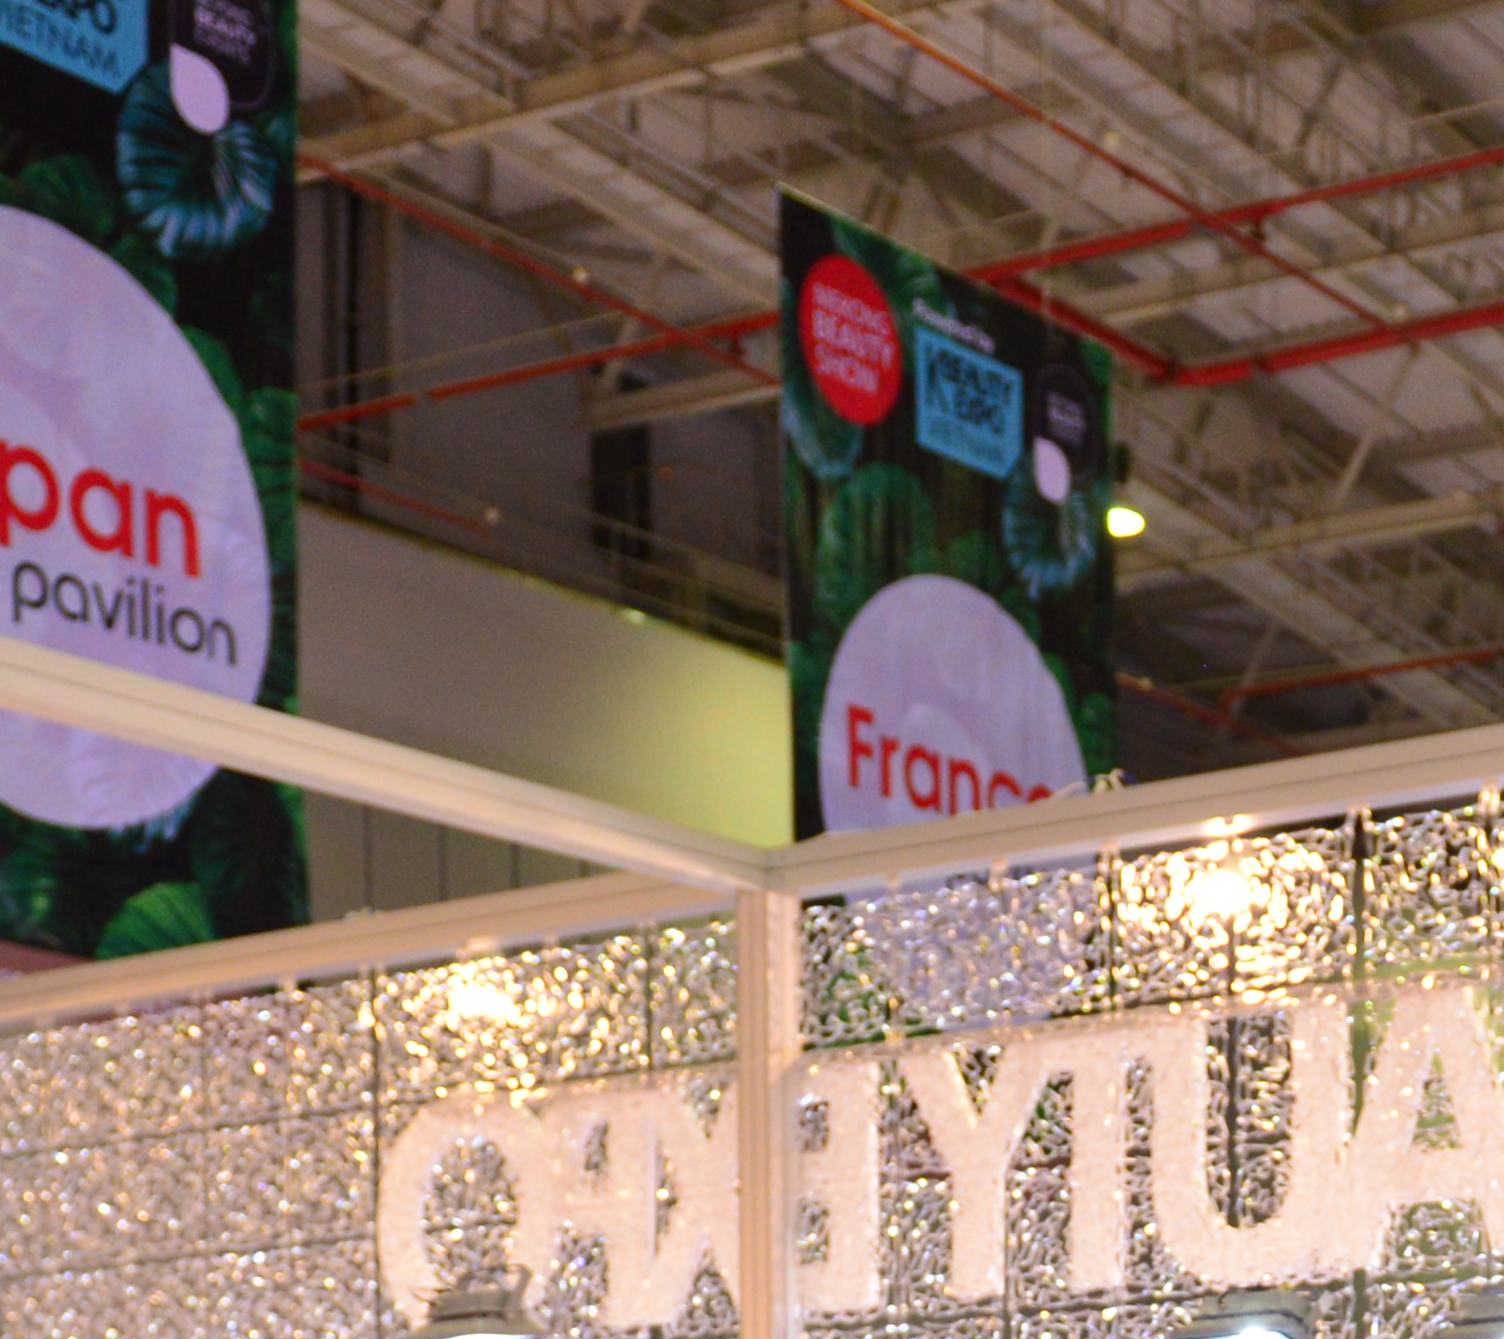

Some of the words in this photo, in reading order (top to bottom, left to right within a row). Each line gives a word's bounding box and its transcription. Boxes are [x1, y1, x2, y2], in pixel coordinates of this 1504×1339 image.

[812, 309, 893, 369] BEAUTY
[815, 343, 881, 395] SHOW
[12, 558, 240, 667] pavilion
